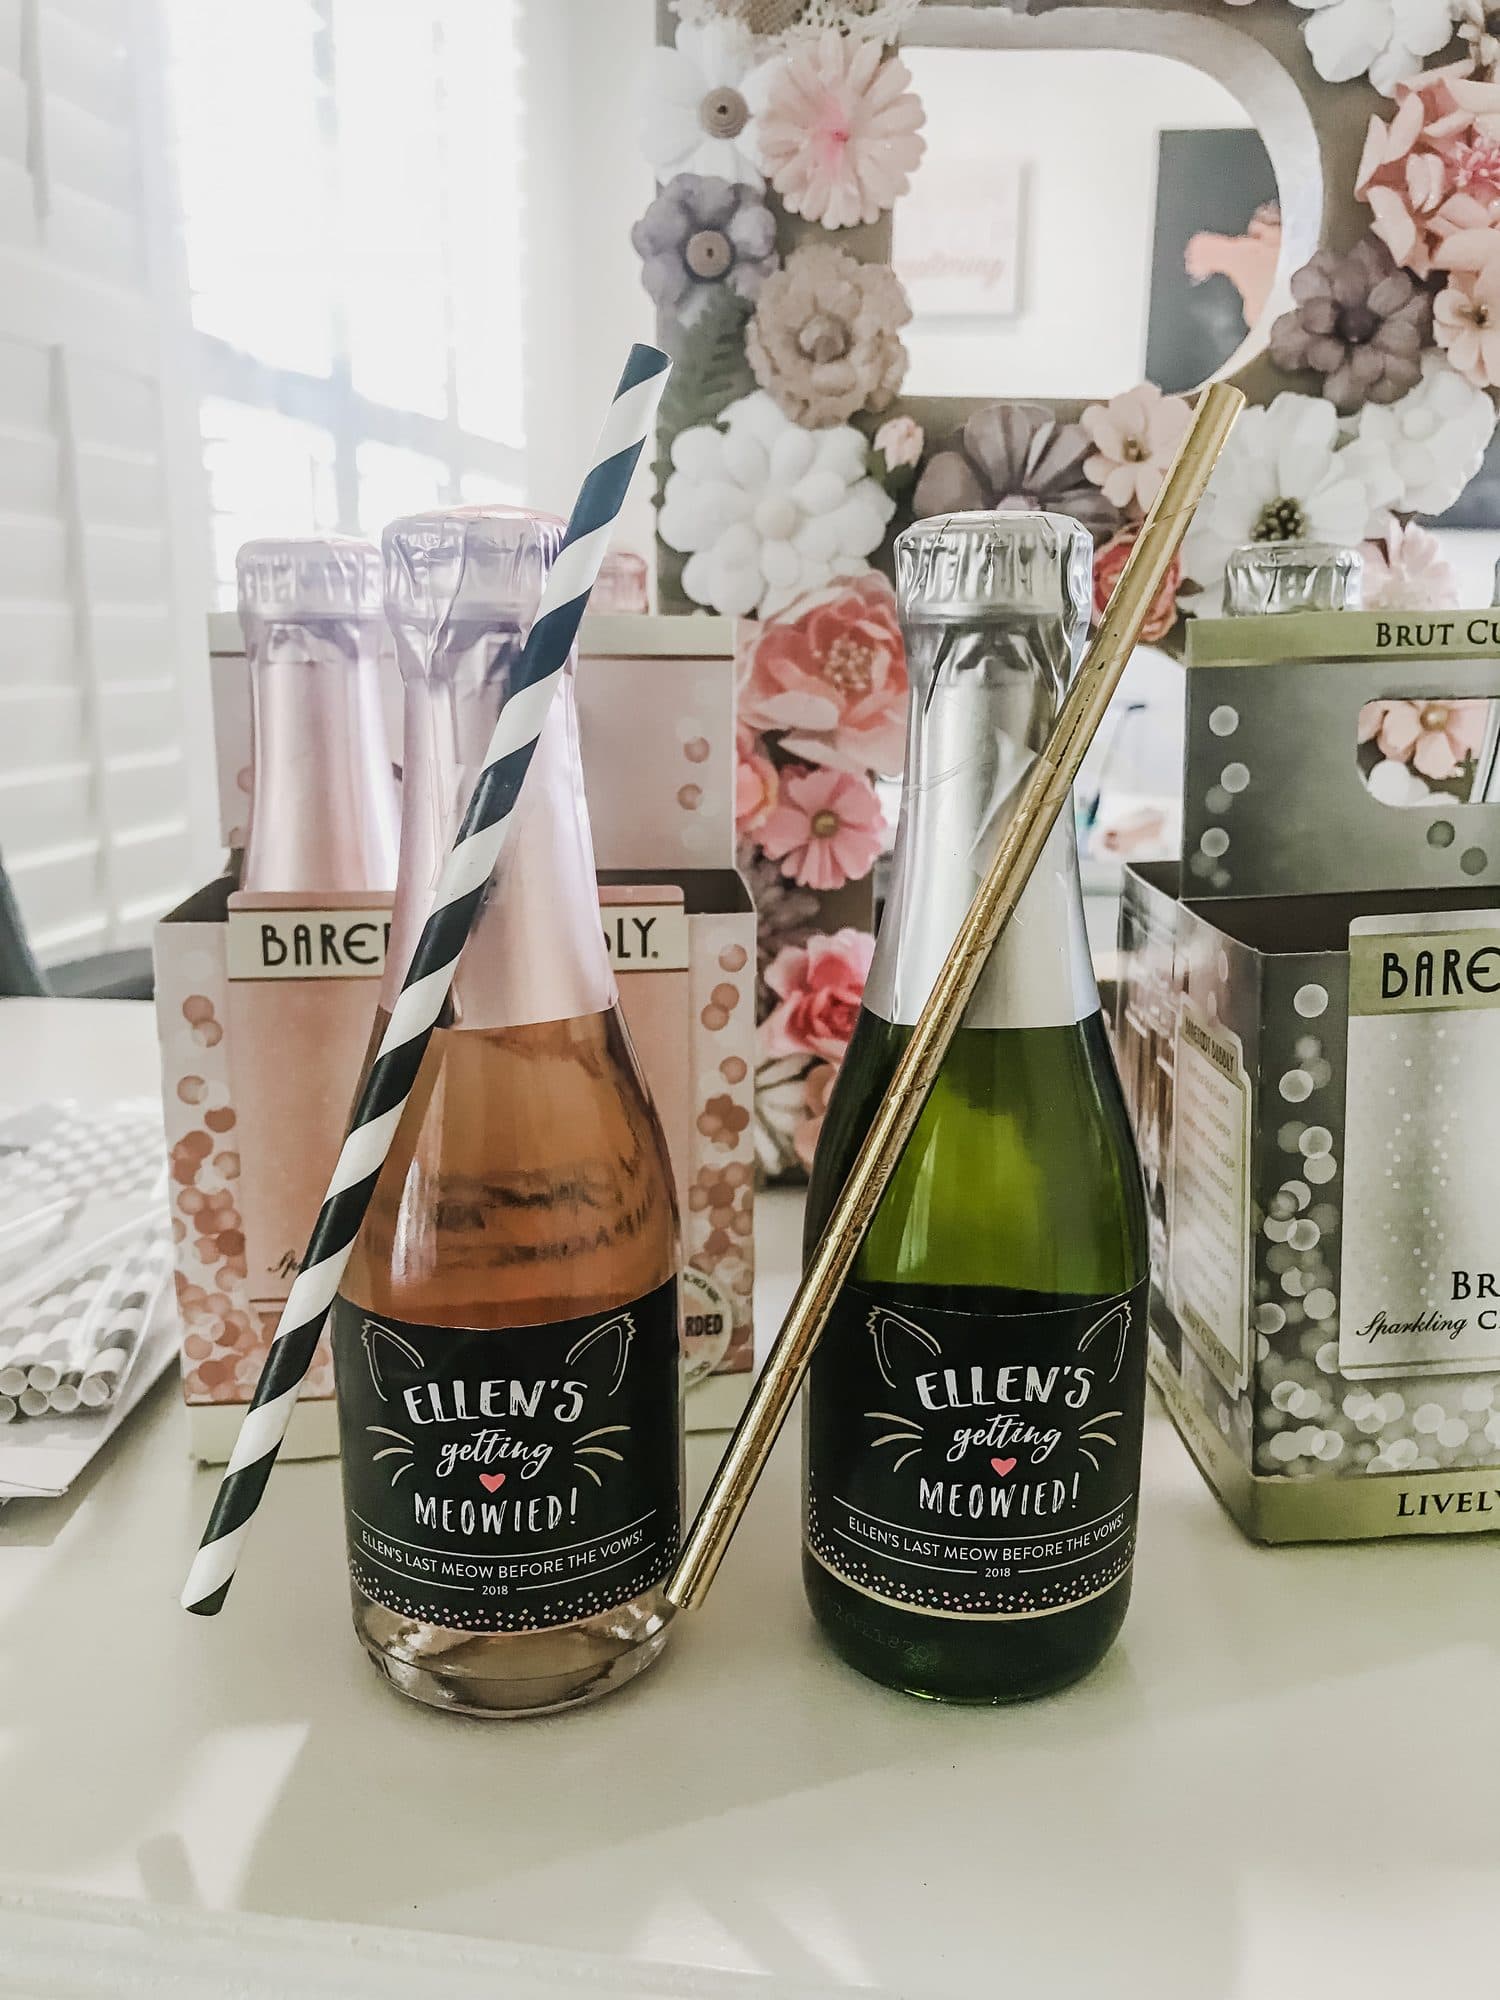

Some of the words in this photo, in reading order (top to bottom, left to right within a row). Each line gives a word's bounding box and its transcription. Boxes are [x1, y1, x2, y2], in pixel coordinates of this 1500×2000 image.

[1376, 622, 1454, 648] BRUT
[261, 922, 391, 967] BARE
[1382, 946, 1500, 999] BARE
[1451, 1271, 1500, 1300] BR
[1356, 1310, 1468, 1344] Sparkling
[1477, 1310, 1500, 1330] C
[403, 1379, 588, 1425] ELLEN'S
[915, 1365, 1095, 1410] ELLEN'S
[436, 1429, 554, 1480] getting
[946, 1414, 1062, 1464] getting
[414, 1487, 578, 1535] MEOWIED!
[919, 1472, 1080, 1519] MEOWIED!
[1397, 1489, 1500, 1517] LIVEL
[362, 1530, 402, 1562] ELLEN'S
[405, 1552, 438, 1573] LAST
[441, 1561, 493, 1579] MEOW
[498, 1558, 563, 1579] BEFORE
[567, 1549, 597, 1568] THE
[600, 1529, 643, 1558] VOWS!
[849, 1516, 899, 1548] ELLEN'S
[904, 1538, 941, 1557] LAST
[944, 1546, 998, 1561] MEOW
[1003, 1541, 1063, 1561] BEFORE
[1066, 1532, 1091, 1552] THE
[482, 1585, 509, 1596] 2018
[985, 1567, 1011, 1578] 2018
